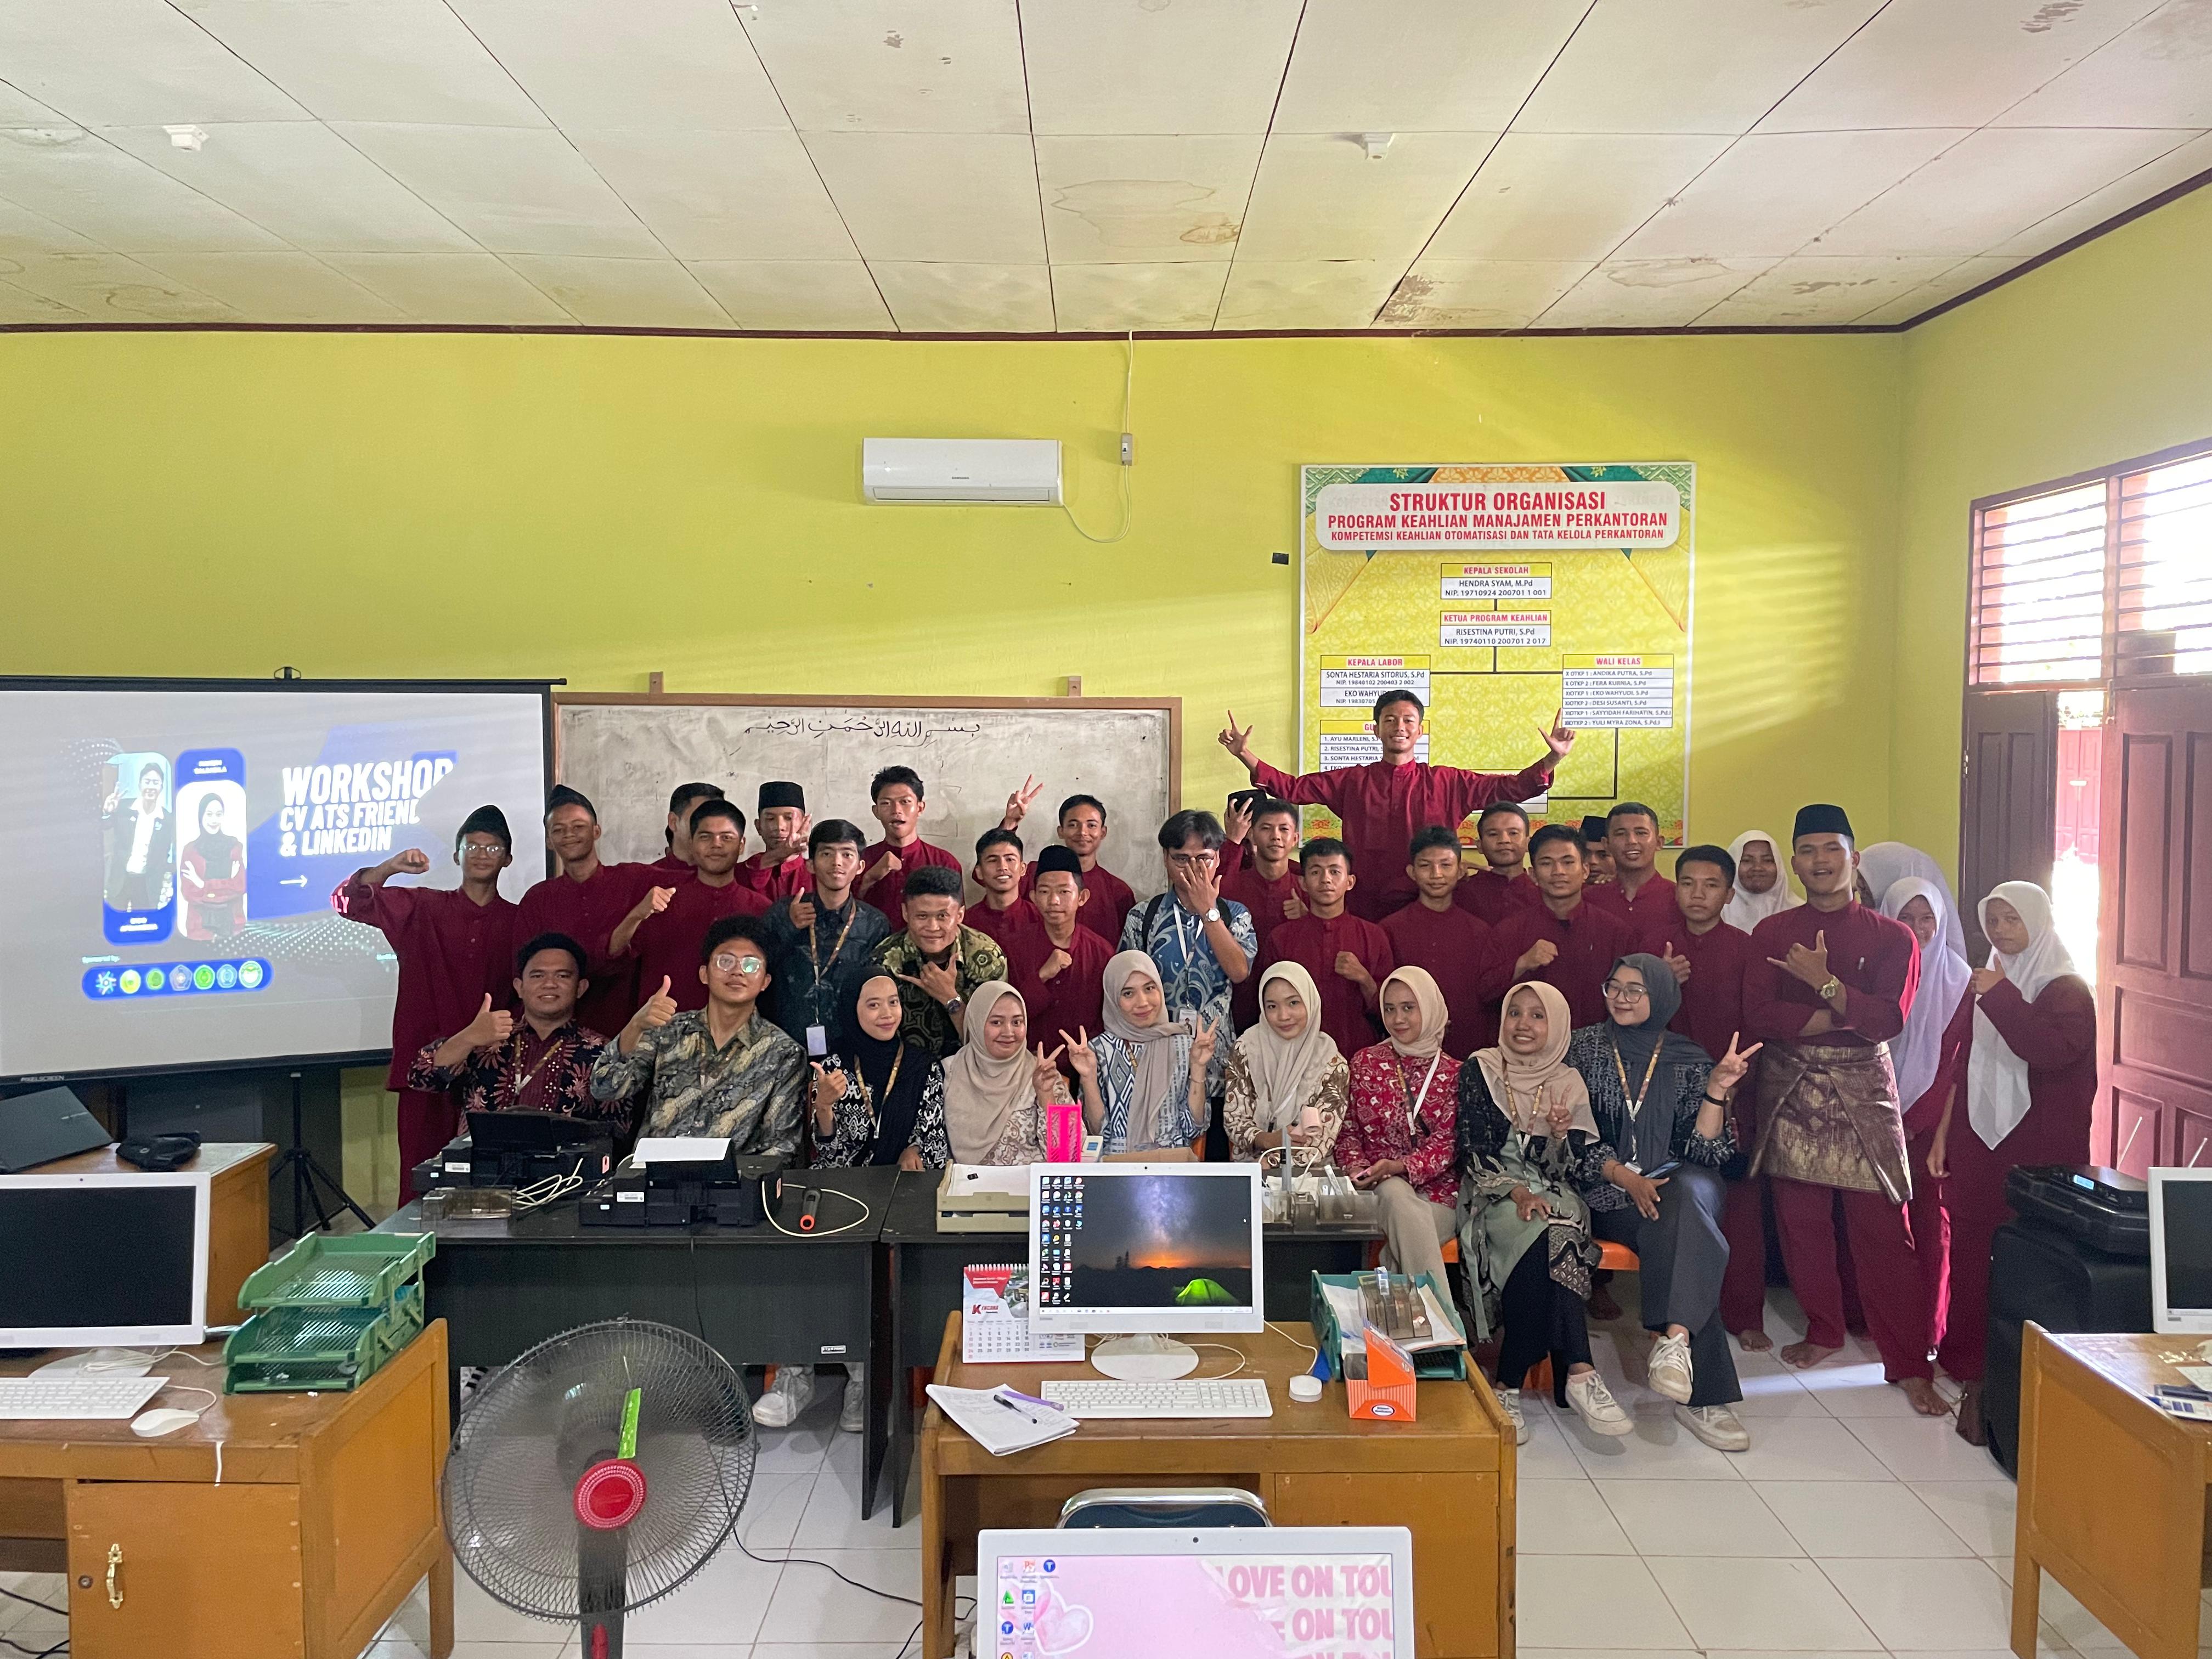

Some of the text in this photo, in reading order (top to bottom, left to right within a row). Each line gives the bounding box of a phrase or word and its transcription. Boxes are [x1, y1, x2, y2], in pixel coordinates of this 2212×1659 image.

[1389, 493, 1486, 511] STRUKTUR
[1493, 492, 1605, 511] ORGANISASI
[1328, 512, 1667, 528] PROGRAM KEAHLIAN MANAJAMEN PERKANTORAN
[1331, 529, 1663, 541] KOMPETEMSI KEAHLIAN OTOMATISASI DAN TATA KELOLA PERKANTORAN
[281, 758, 454, 806] WORKSHOP
[280, 805, 308, 832] CV
[310, 803, 350, 830] ATS
[280, 826, 392, 857] & LINKEDIN
[1214, 1565, 1285, 1598] OVE
[1291, 1565, 1334, 1598] ON
[1293, 1608, 1335, 1641] ON
